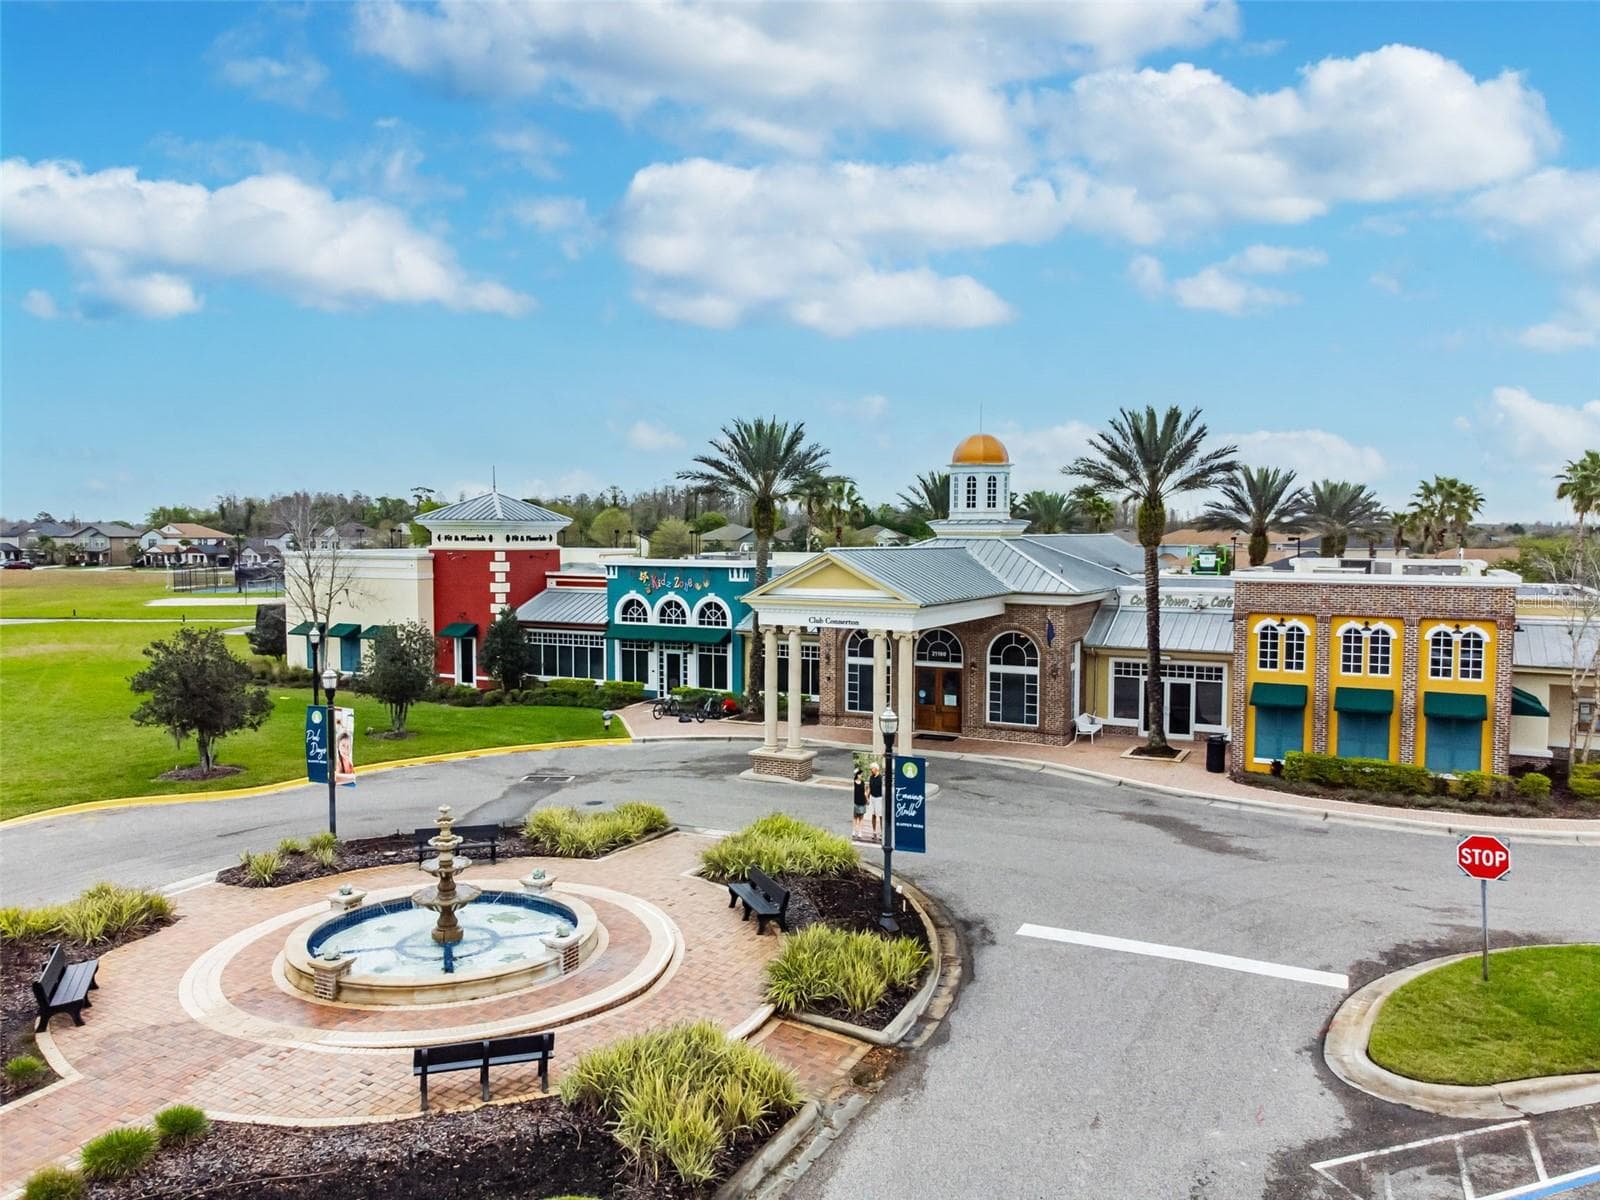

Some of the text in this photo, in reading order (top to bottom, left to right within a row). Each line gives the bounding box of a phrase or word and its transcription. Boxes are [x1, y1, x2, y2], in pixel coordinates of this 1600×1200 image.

[651, 572, 693, 592] Kidz Zone
[808, 616, 860, 626] Club Connerton
[1461, 847, 1507, 868] STOP
